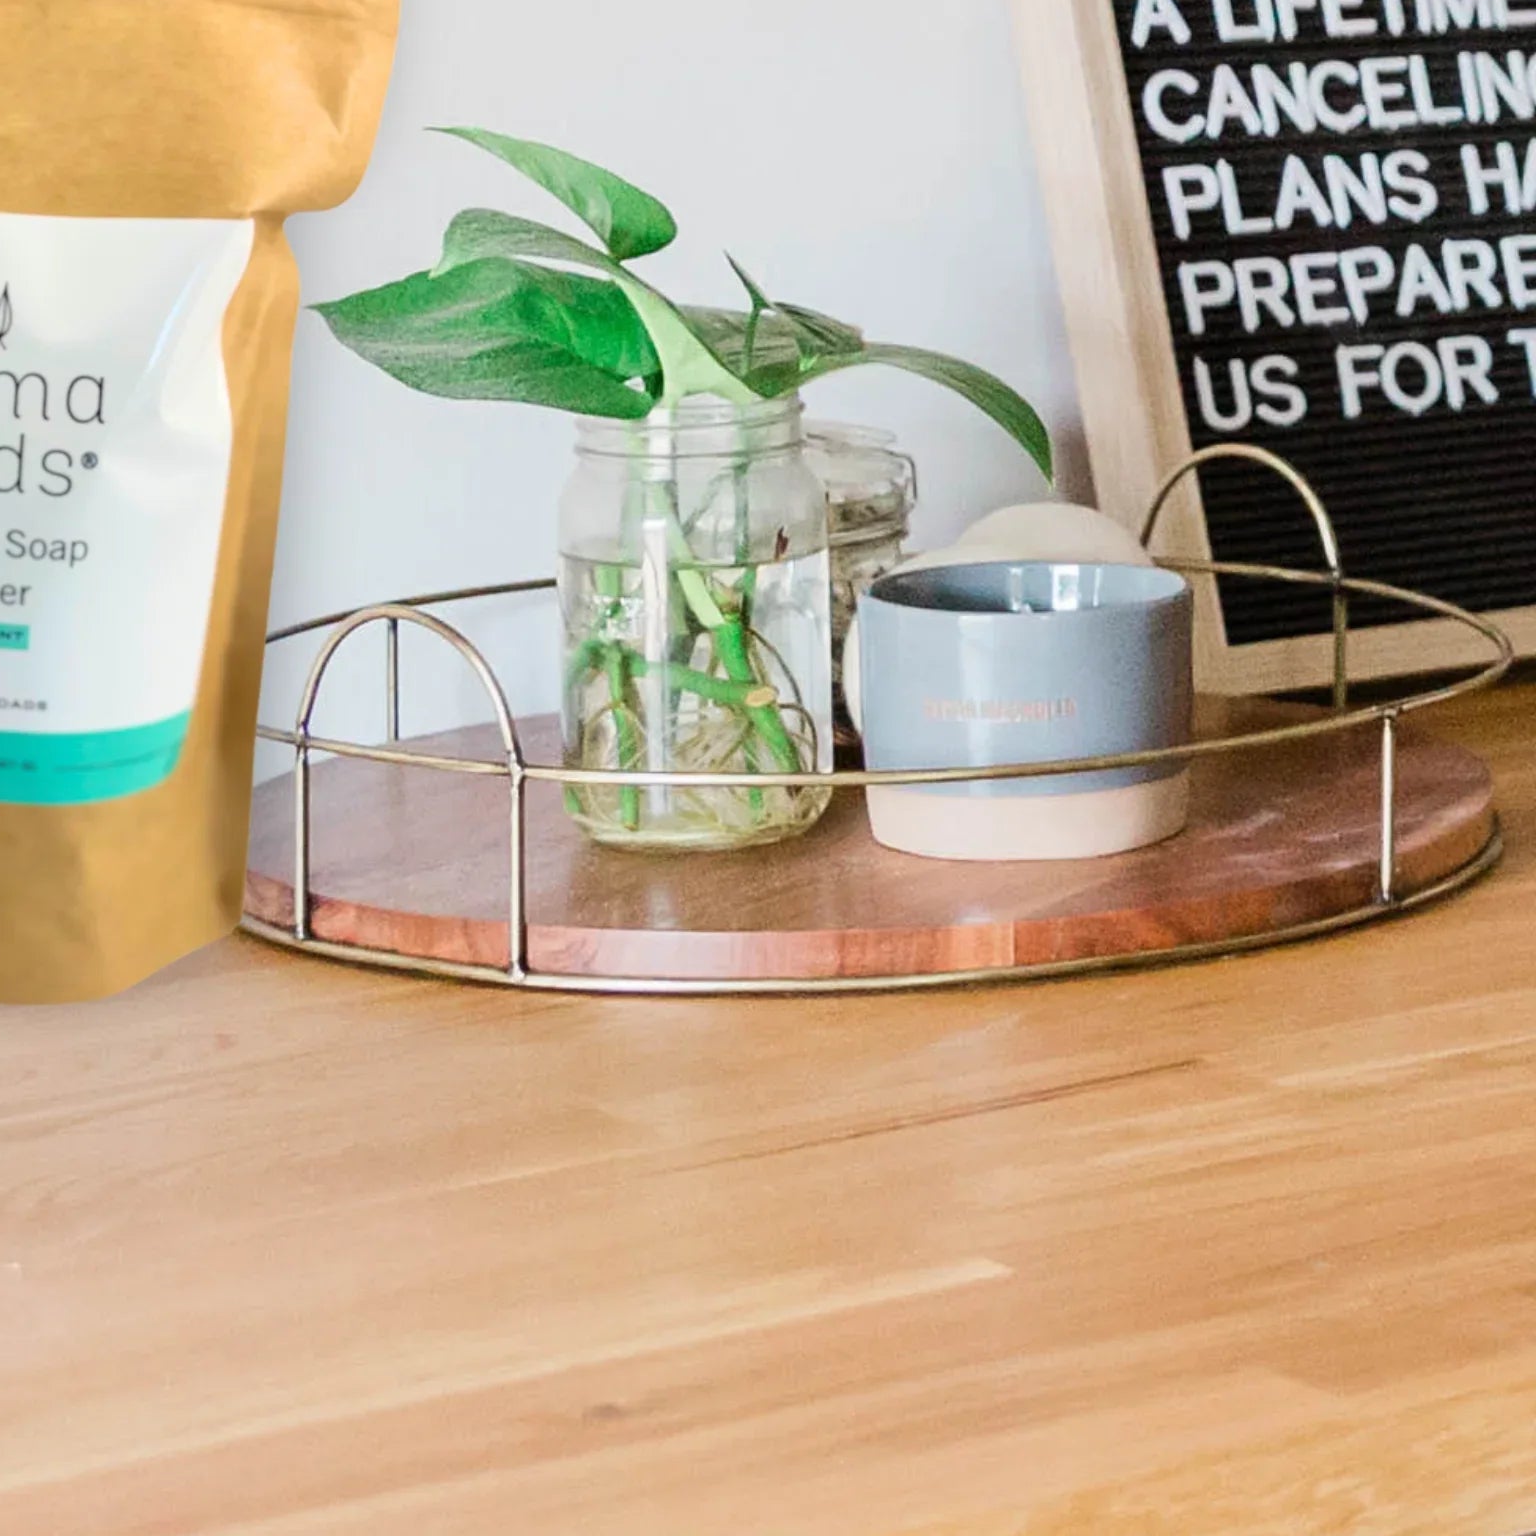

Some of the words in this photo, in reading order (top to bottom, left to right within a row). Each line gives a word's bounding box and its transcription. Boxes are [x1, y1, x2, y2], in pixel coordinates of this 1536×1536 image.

[1142, 49, 1536, 144] CANCELIN
[1161, 149, 1438, 241] PLANS
[1194, 353, 1308, 432] US
[1336, 335, 1500, 419] FOR
[5, 529, 89, 568] Soap
